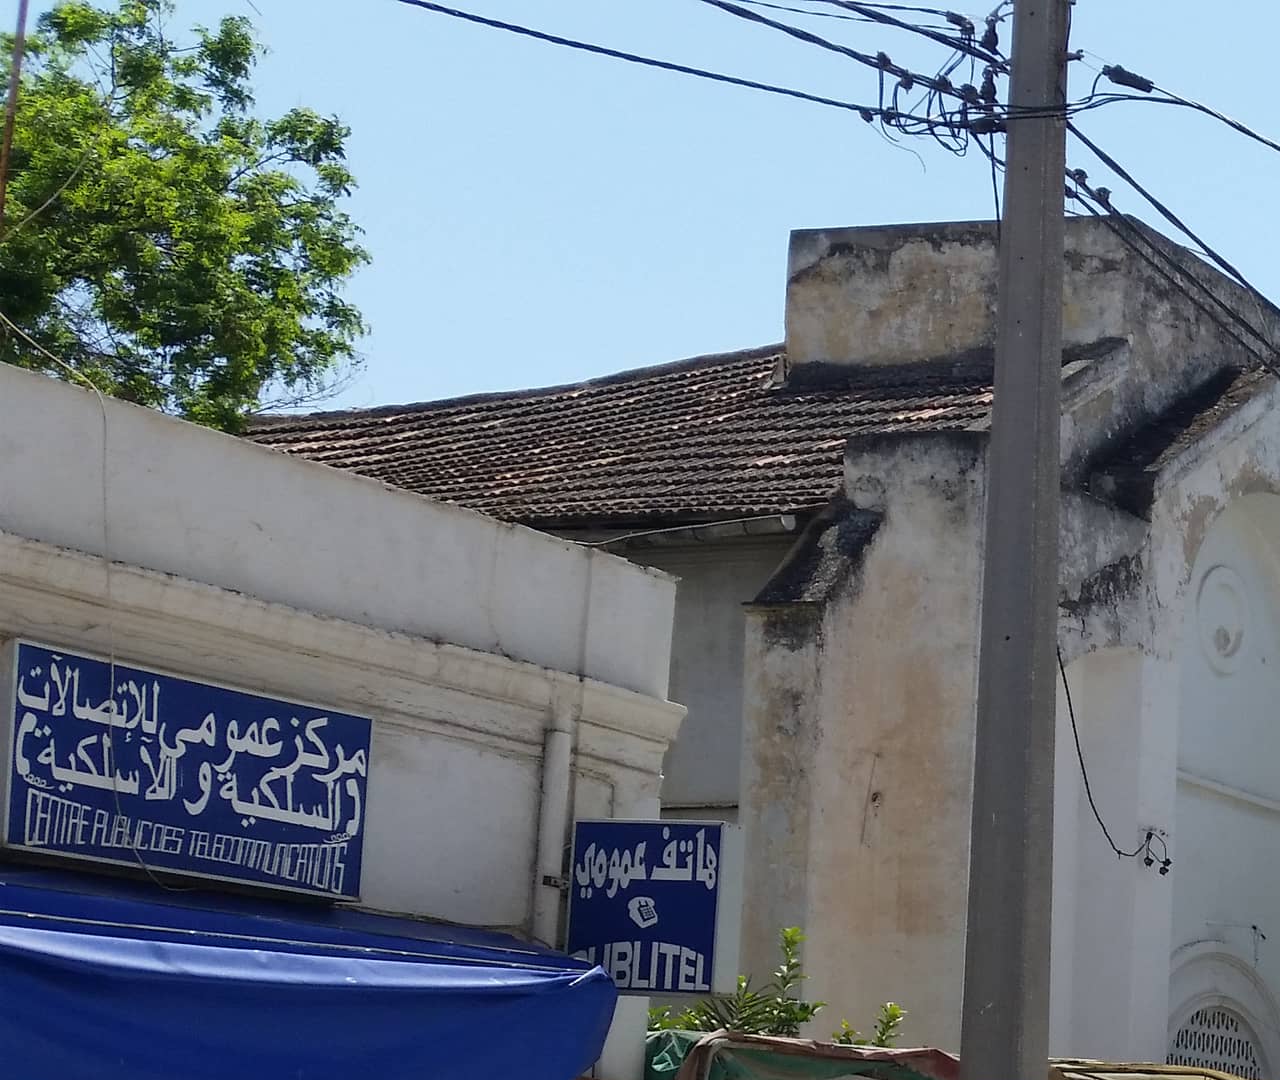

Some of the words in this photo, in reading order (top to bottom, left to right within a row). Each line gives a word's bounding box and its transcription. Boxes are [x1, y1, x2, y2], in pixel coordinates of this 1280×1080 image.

[270, 716, 366, 783] مركز
[24, 786, 92, 848] CENTRE
[90, 808, 150, 852] PUBLIC
[575, 840, 647, 899] عمومي
[650, 826, 718, 890] هاتف
